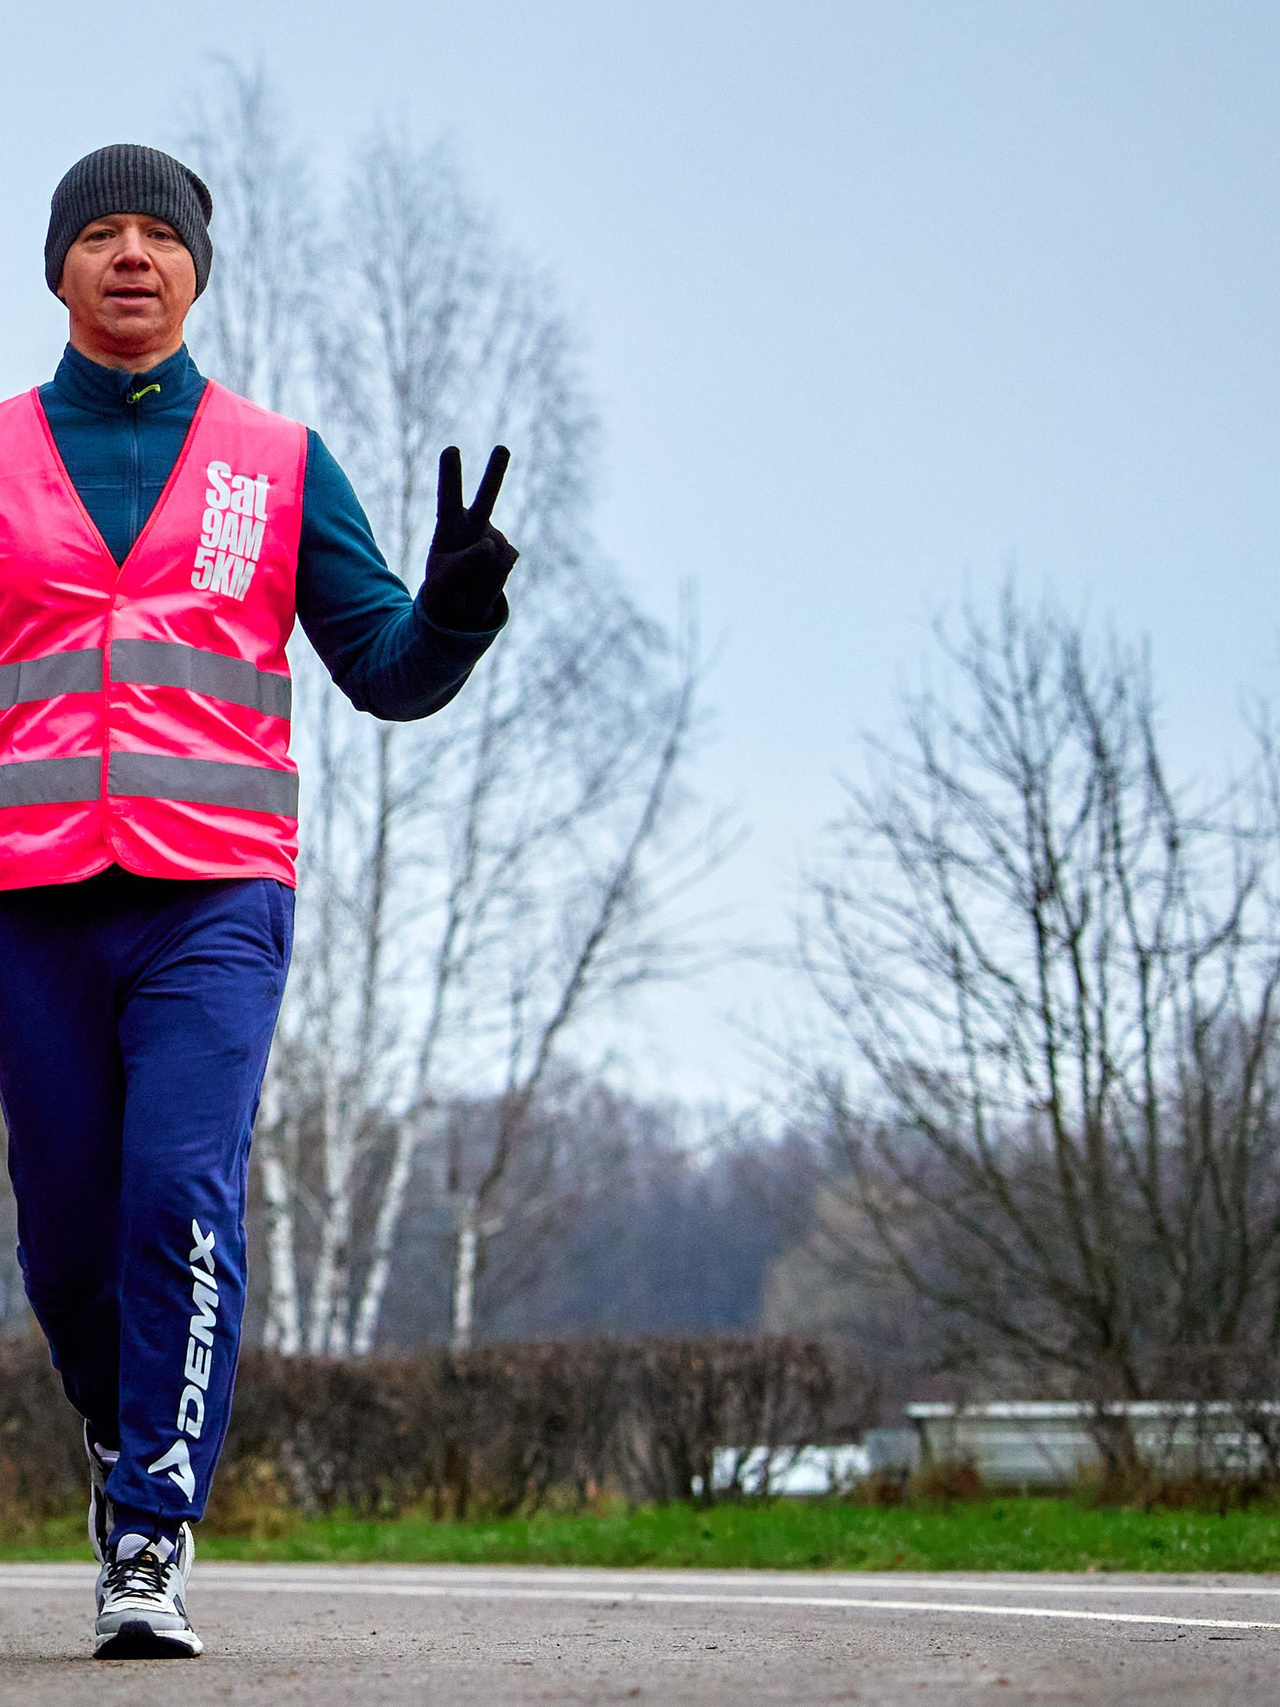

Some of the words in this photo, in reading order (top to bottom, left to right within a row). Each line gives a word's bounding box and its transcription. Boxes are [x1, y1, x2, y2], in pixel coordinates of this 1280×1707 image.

[206, 461, 270, 521] Sat
[201, 508, 266, 561] 9AM
[190, 546, 256, 601] 5KM
[177, 1219, 219, 1439] DEMIX
